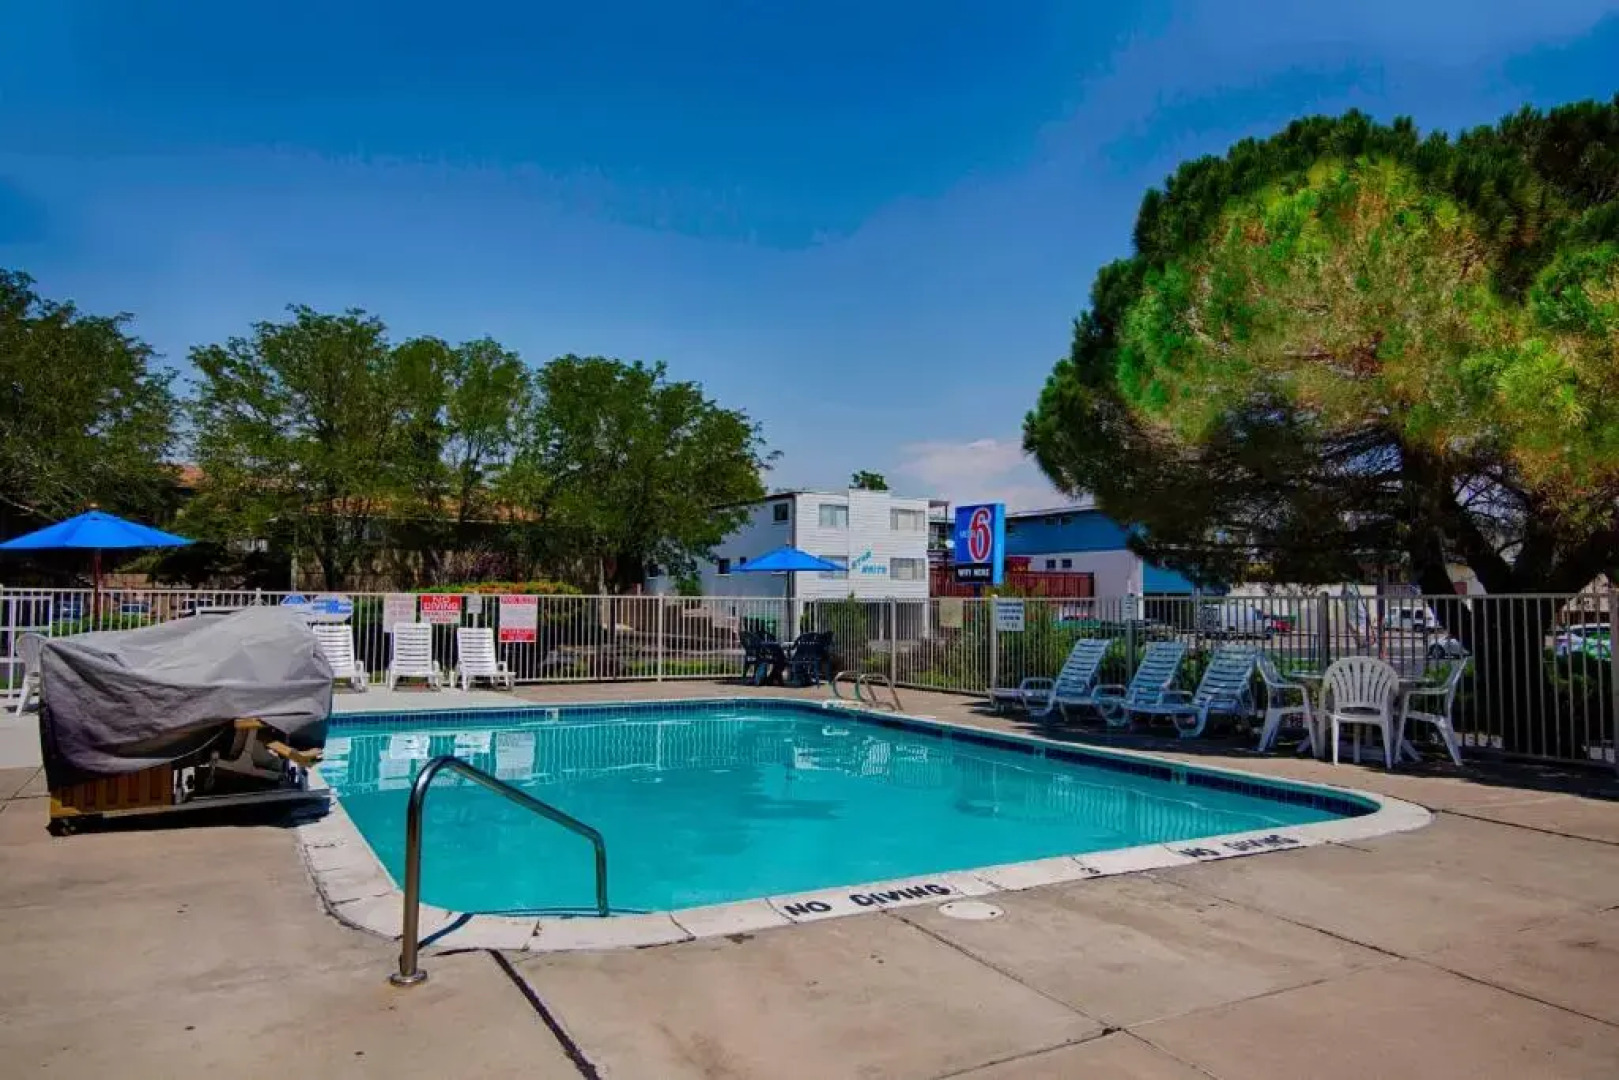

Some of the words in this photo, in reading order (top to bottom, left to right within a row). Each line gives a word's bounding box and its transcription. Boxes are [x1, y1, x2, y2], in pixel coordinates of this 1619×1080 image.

[969, 508, 992, 563] 6
[422, 602, 458, 611] DIVING
[432, 595, 451, 603] NO
[784, 900, 832, 917] NO
[849, 883, 951, 907] DIVING
